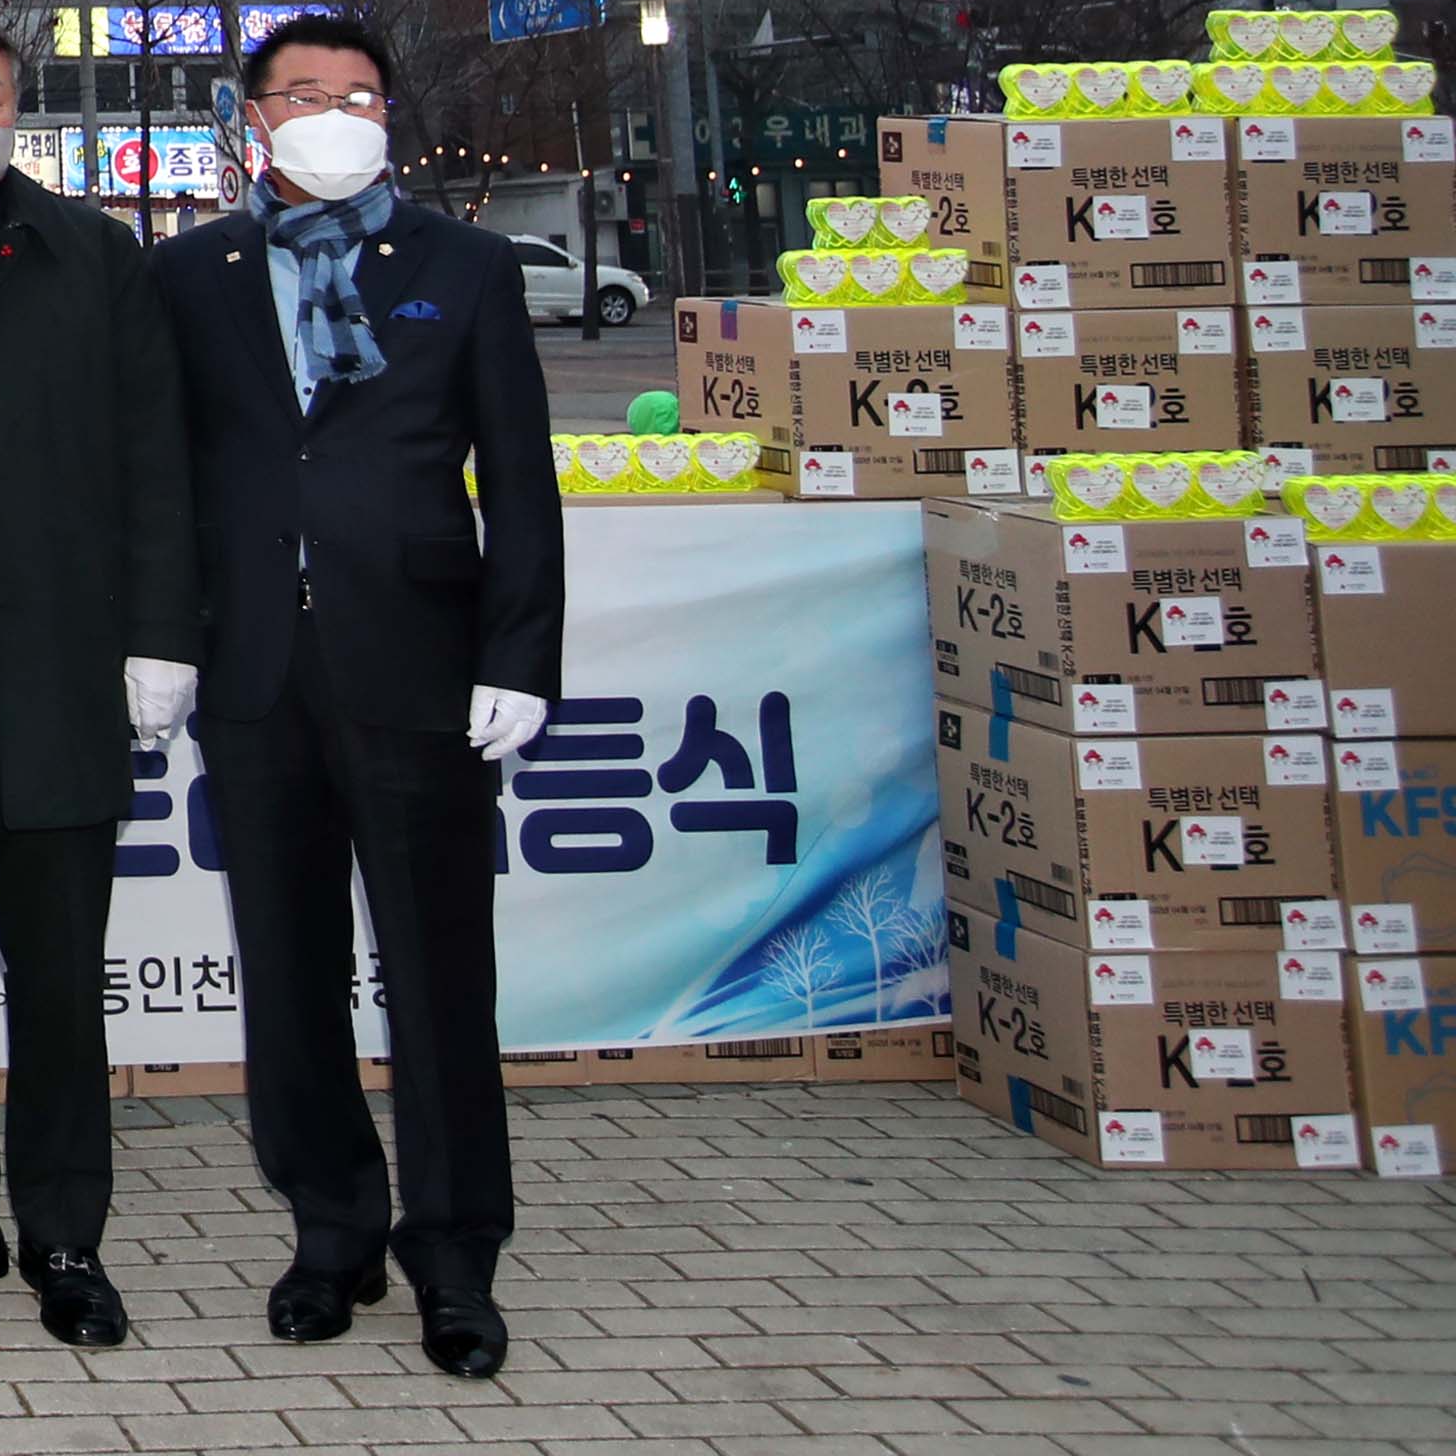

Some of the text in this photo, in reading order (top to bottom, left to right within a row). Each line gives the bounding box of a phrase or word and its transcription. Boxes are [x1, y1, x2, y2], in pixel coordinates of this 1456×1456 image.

[1071, 165, 1169, 189] 특별한 선택
[1303, 161, 1400, 184] 특별한 선택
[854, 350, 951, 374] 특별한 선택
[1079, 352, 1179, 376] 특별한 선택
[1312, 347, 1410, 370] 특별한 선택
[702, 375, 762, 420] K-2호
[1131, 567, 1242, 595] 특별한 선택
[956, 585, 1026, 639] K-2호
[1147, 785, 1260, 812] 특별한 선택
[965, 788, 1038, 849] K-2호
[976, 991, 1050, 1060] K-2호
[1162, 1000, 1275, 1026] 특별한 선택
